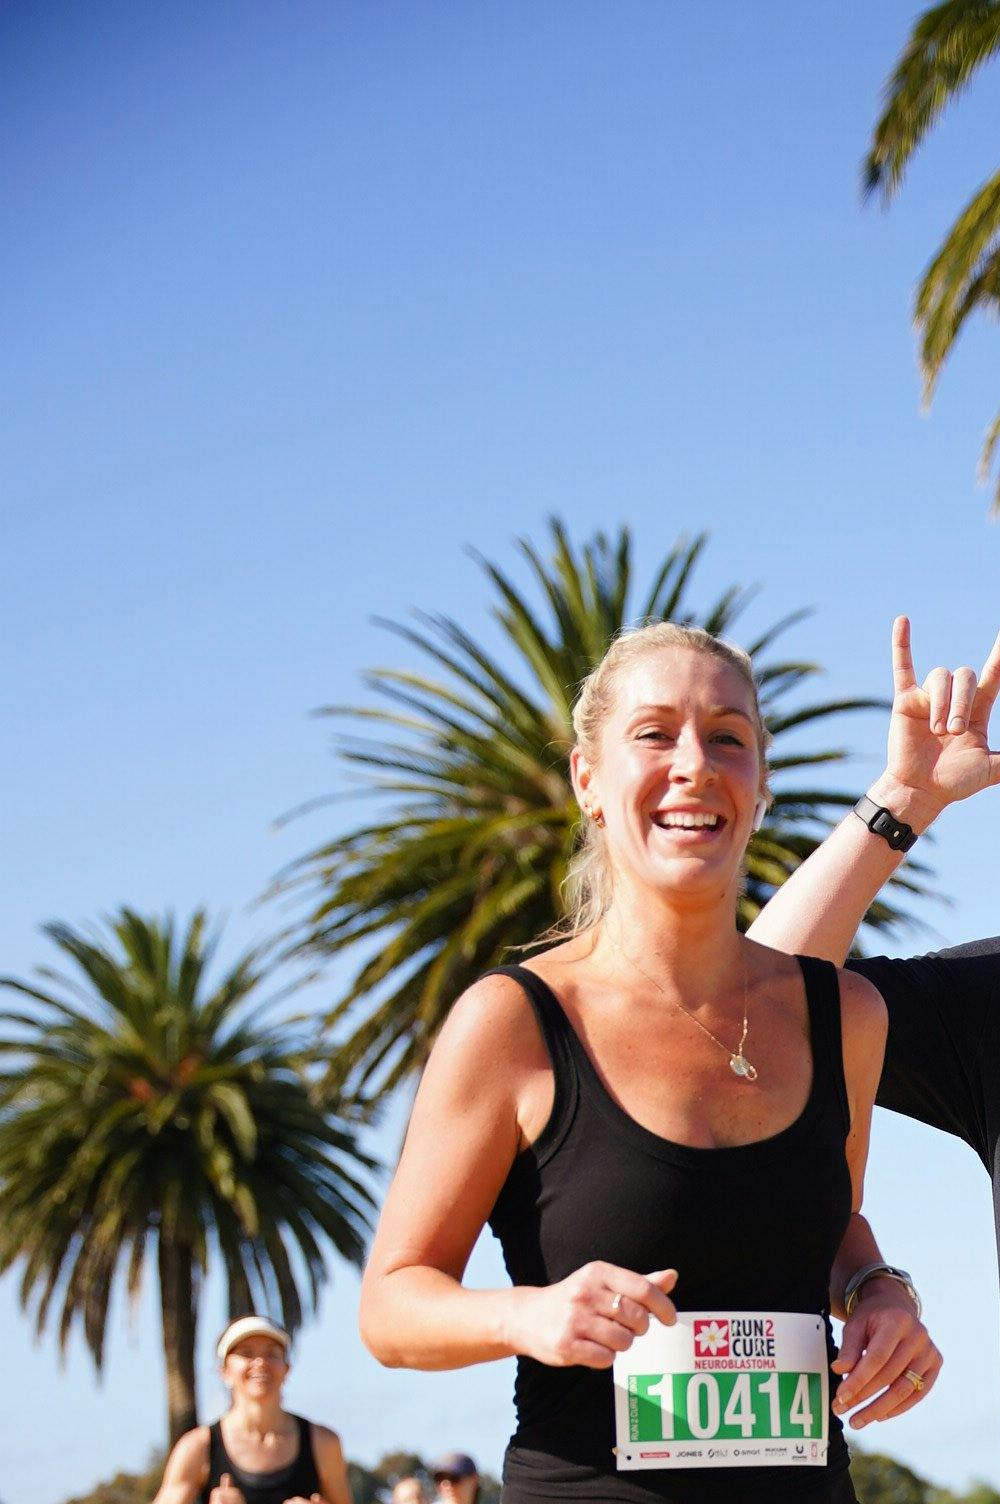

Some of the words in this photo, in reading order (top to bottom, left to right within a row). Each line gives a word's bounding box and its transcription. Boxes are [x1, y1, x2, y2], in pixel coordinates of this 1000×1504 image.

[732, 1338, 775, 1357] CURE
[694, 1359, 777, 1370] NEUROBLASTOMA
[647, 1373, 814, 1440] 10414
[676, 1450, 703, 1458] JONES
